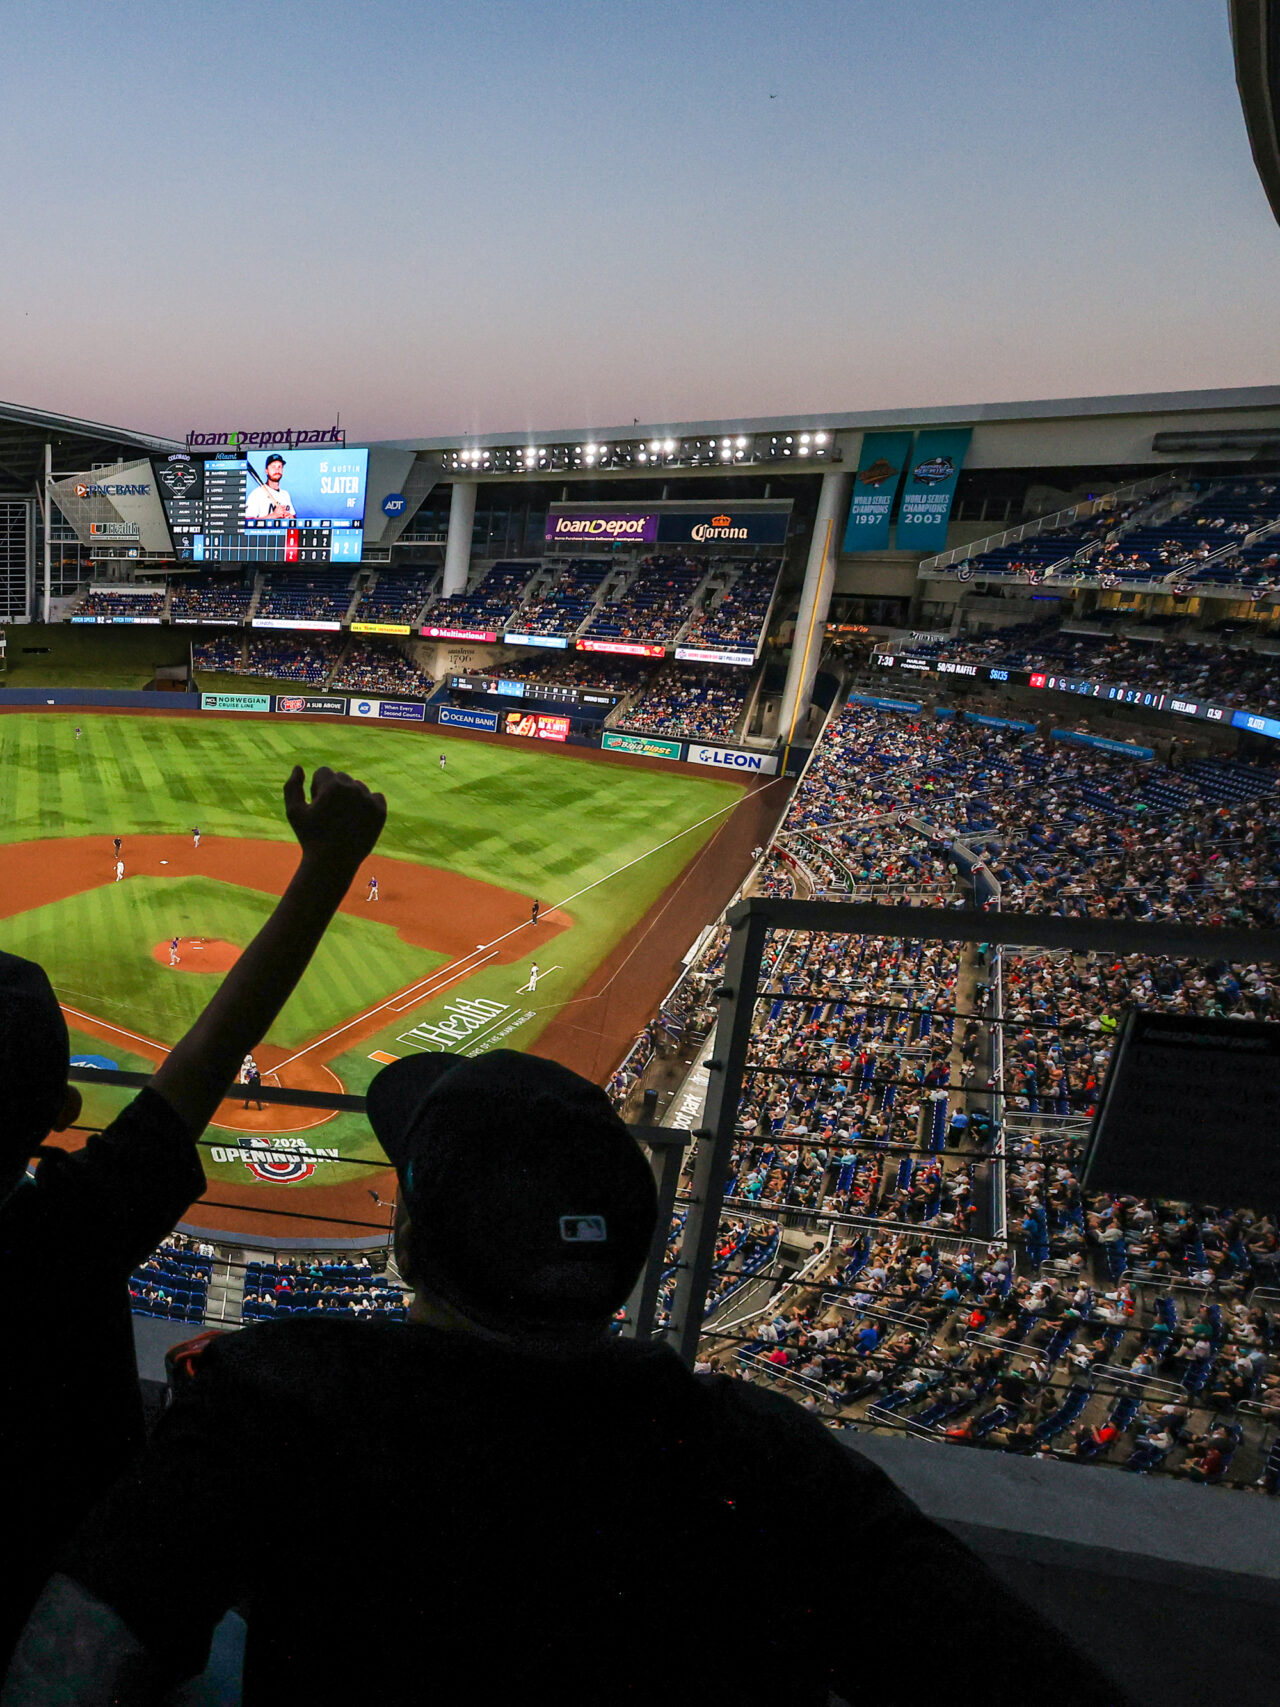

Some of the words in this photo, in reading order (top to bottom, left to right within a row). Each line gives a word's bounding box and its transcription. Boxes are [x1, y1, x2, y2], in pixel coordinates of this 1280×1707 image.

[189, 428, 292, 448] loanDepot
[295, 426, 341, 447] park
[332, 464, 360, 473] AUSTIN
[89, 484, 116, 495] PNC
[116, 484, 151, 496] BANK
[320, 476, 359, 494] SLATER
[384, 501, 403, 510] ADT
[854, 496, 872, 505] WORLD
[872, 496, 891, 504] SERIES
[904, 495, 927, 504] WORLD
[927, 495, 950, 504] SERIES
[852, 505, 889, 514] CHAMPIONS
[903, 504, 948, 513] CHAMPIONS
[855, 515, 882, 524] 1997
[904, 514, 942, 524] 2003
[556, 517, 646, 536] loanDepot
[691, 523, 748, 542] Corona
[97, 616, 105, 624] 92
[439, 629, 486, 640] Multinational
[937, 663, 955, 673] 50/50
[955, 665, 977, 676] RAFFLE
[1093, 685, 1100, 696] 2
[612, 697, 617, 705] 3
[1170, 700, 1198, 714] FREELAND
[451, 713, 474, 723] OCEAN
[475, 718, 495, 727] BANK
[1247, 717, 1265, 731] SLATER
[621, 740, 643, 752] Baja
[643, 744, 672, 755] Blast
[713, 751, 762, 769] LEON
[396, 998, 511, 1053] UHealth
[480, 1042, 491, 1050] OF
[488, 1035, 502, 1044] THE
[497, 1024, 515, 1038] MIAMI
[512, 1011, 536, 1027] MARLINS
[272, 1138, 307, 1148] 2026
[210, 1147, 300, 1163] OPENING
[300, 1148, 340, 1163] DAY
